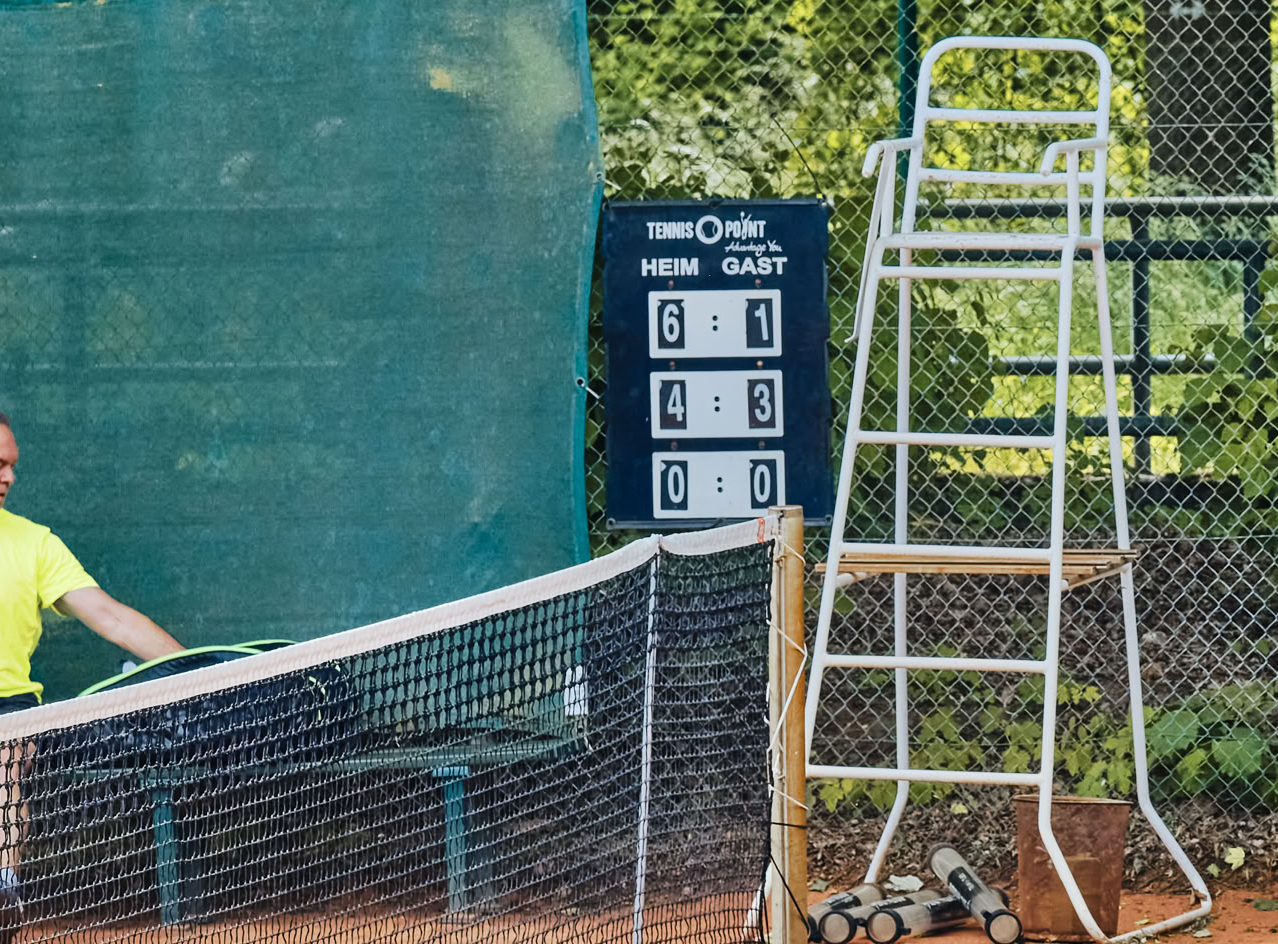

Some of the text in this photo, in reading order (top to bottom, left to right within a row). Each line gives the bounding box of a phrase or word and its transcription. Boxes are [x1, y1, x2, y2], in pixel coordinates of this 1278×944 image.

[646, 221, 694, 240] TENNIS
[641, 257, 700, 277] HEIM
[721, 256, 788, 275] GAST
[662, 303, 680, 343] 6
[754, 303, 770, 341] 1
[667, 384, 685, 422] 4
[753, 383, 772, 422] 3
[667, 464, 685, 504] 0
[754, 463, 771, 503] 0
